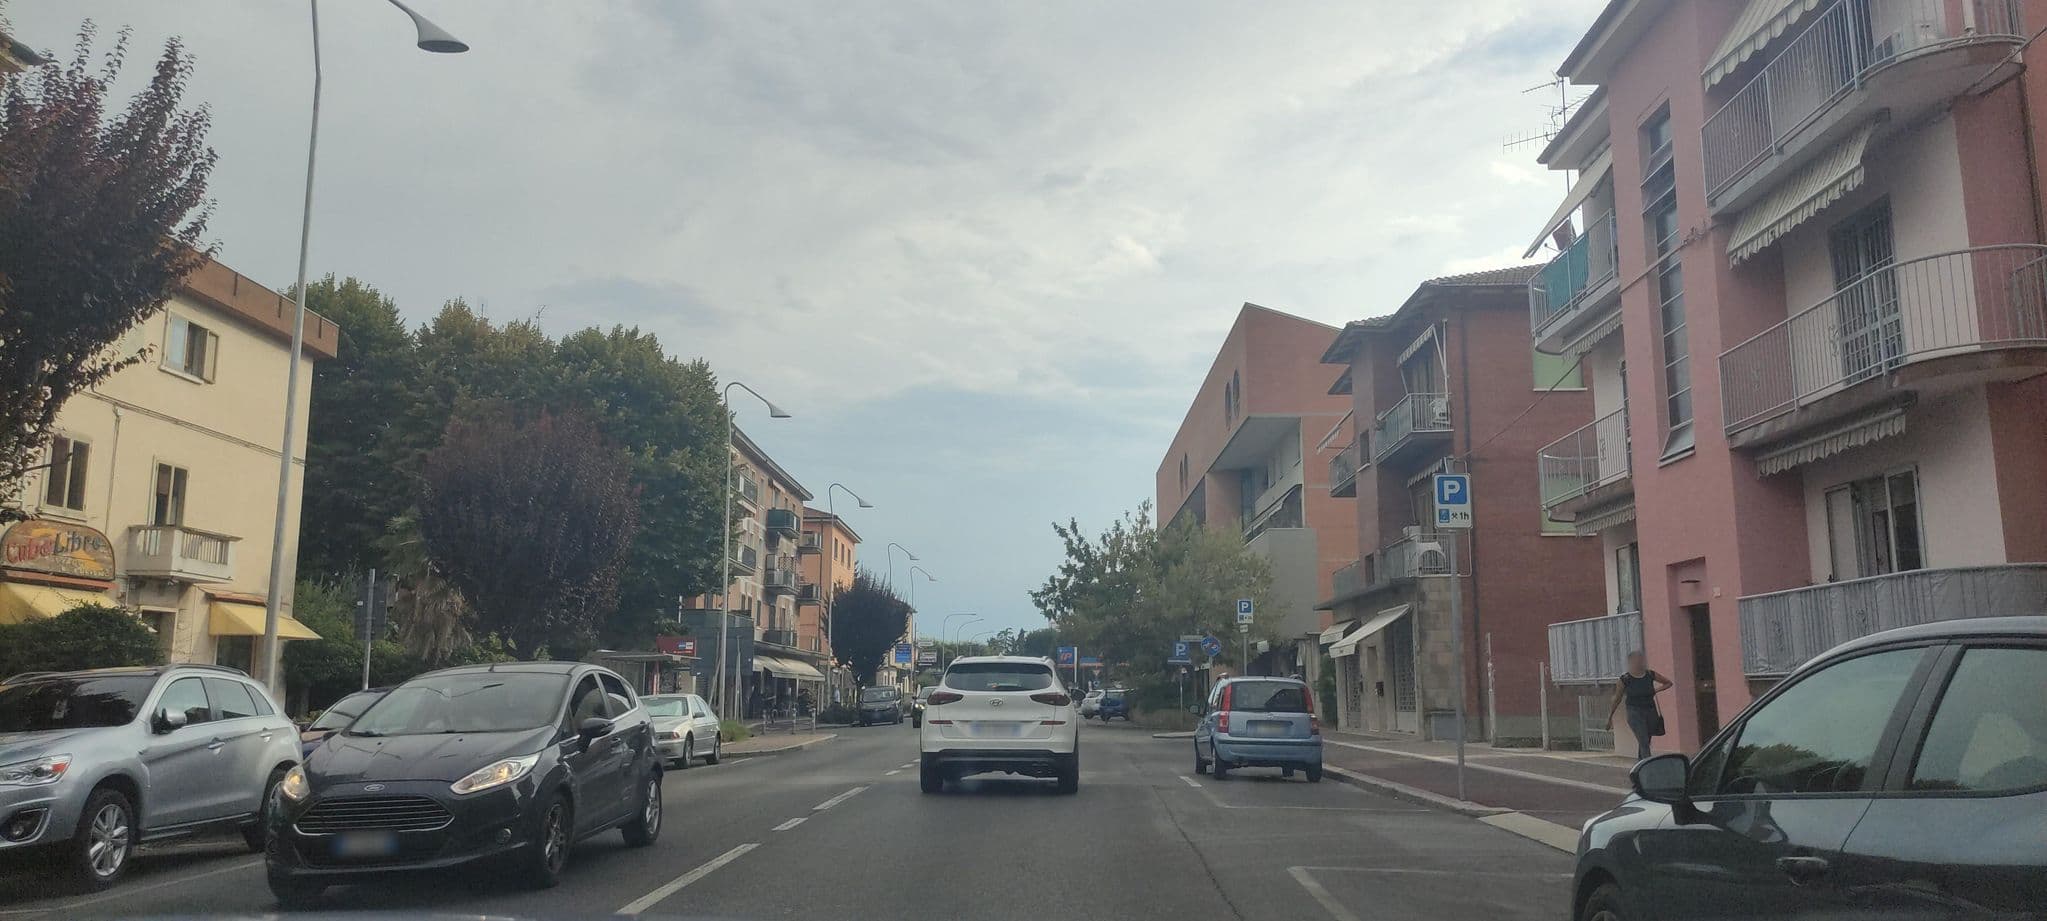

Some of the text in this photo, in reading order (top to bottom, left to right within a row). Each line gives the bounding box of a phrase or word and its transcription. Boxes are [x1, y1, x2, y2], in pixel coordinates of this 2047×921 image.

[1443, 480, 1460, 501] P
[1459, 511, 1470, 520] 1h
[1241, 602, 1249, 612] P
[1176, 643, 1186, 656] P
